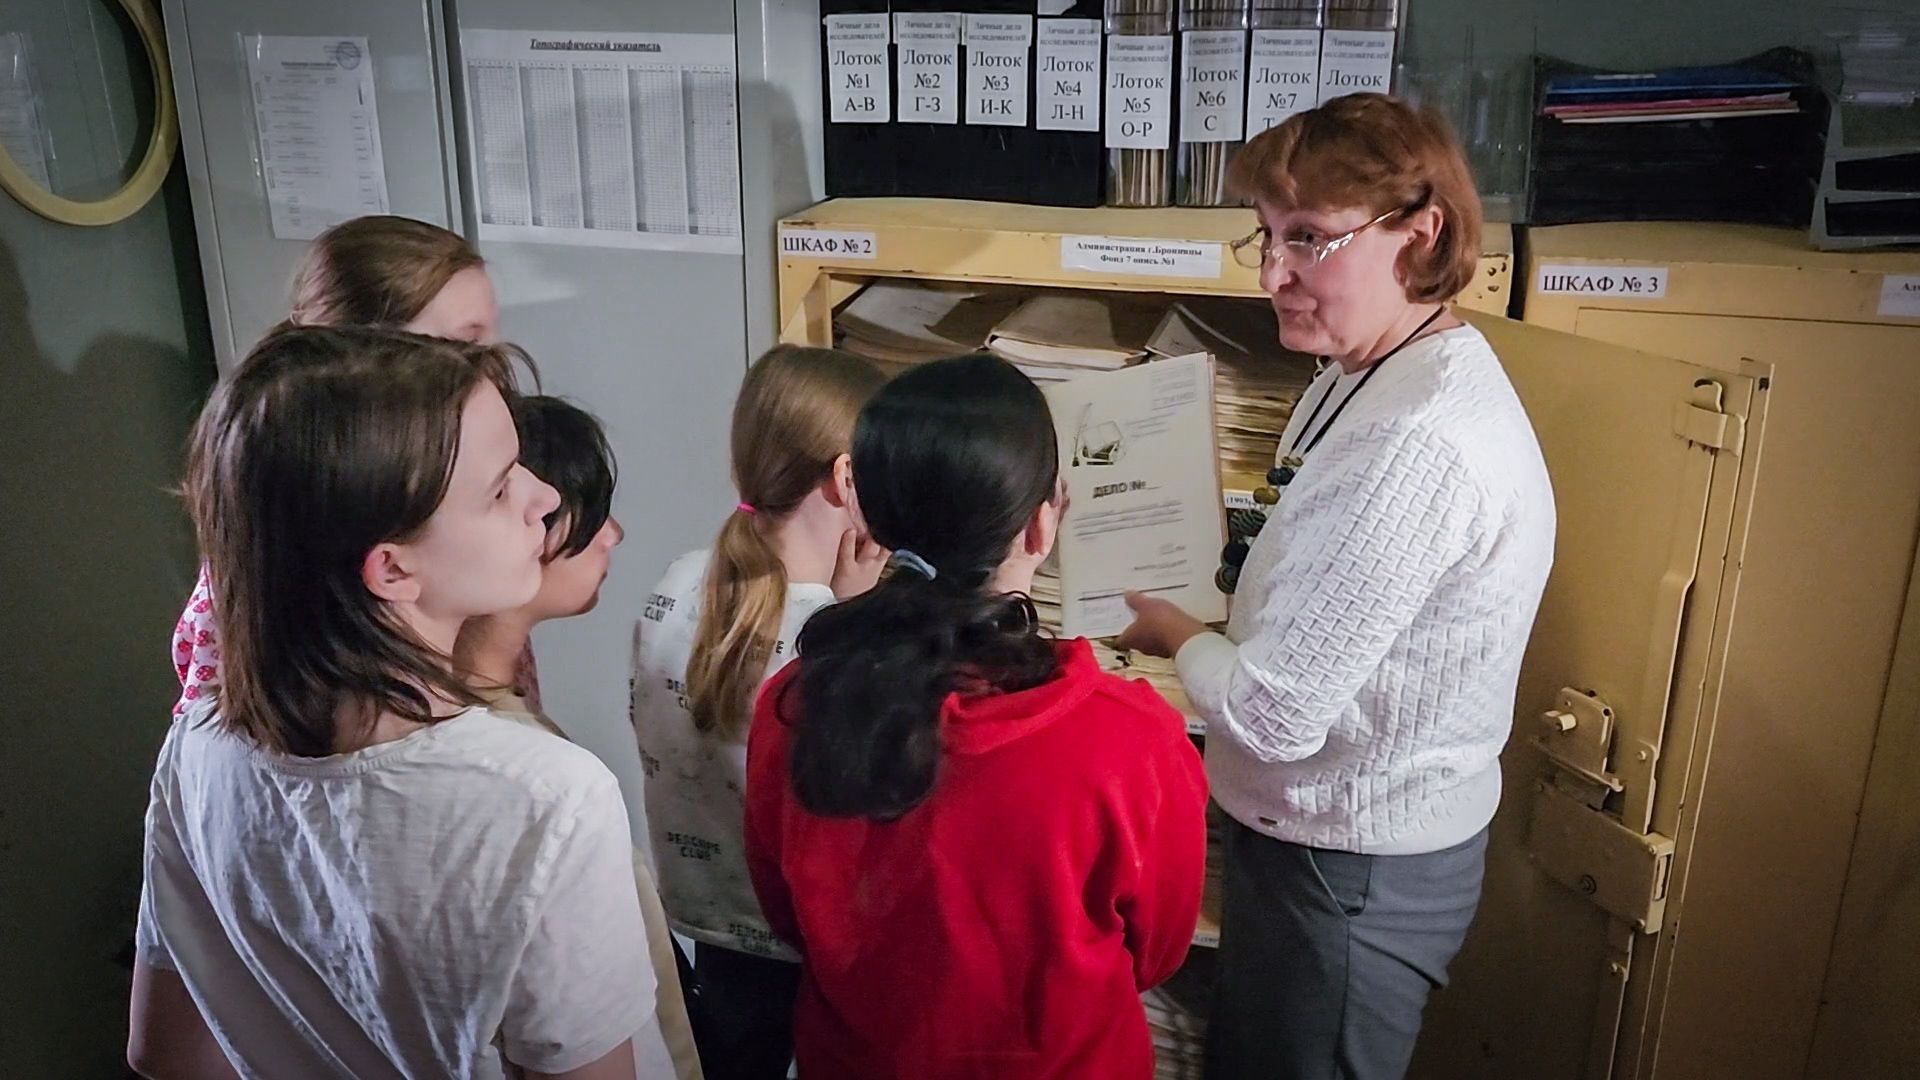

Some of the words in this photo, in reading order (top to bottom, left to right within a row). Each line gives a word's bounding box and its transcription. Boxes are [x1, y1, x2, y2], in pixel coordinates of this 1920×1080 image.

[530, 38, 611, 51] Топографический
[612, 41, 662, 53] указатель
[833, 50, 882, 66] Лоток
[903, 49, 952, 65] Лоток
[972, 50, 1022, 67] Лоток
[1043, 55, 1095, 72] Лоток
[845, 73, 870, 89] №1
[914, 73, 941, 89] №2
[982, 75, 1010, 91] №3
[1112, 73, 1164, 90] Лоток
[1186, 66, 1239, 83] Лоток
[1255, 67, 1312, 85] Лоток
[1325, 69, 1383, 87] Лоток
[1053, 80, 1082, 97] №4
[844, 96, 875, 112] А-В
[914, 97, 941, 112] Г-З
[980, 98, 1013, 115] И-К
[1122, 97, 1151, 113] №5
[1196, 90, 1226, 107] №6
[1266, 92, 1298, 110] №7
[1051, 104, 1085, 120] Л-Н
[1120, 121, 1153, 138] О-Р
[1203, 115, 1218, 132] С
[783, 237, 838, 252] ШКАФ
[842, 238, 859, 253] №
[863, 239, 871, 253] 2
[1076, 242, 1146, 253] Администрация
[1100, 255, 1124, 264] Фонд
[1126, 255, 1131, 263] 7
[1133, 257, 1159, 265] опись
[1160, 257, 1175, 266] №1
[1543, 275, 1614, 291] ШКАФ
[1619, 276, 1642, 292] №
[1647, 276, 1658, 293] 3
[1093, 482, 1128, 499] ДЕЛО
